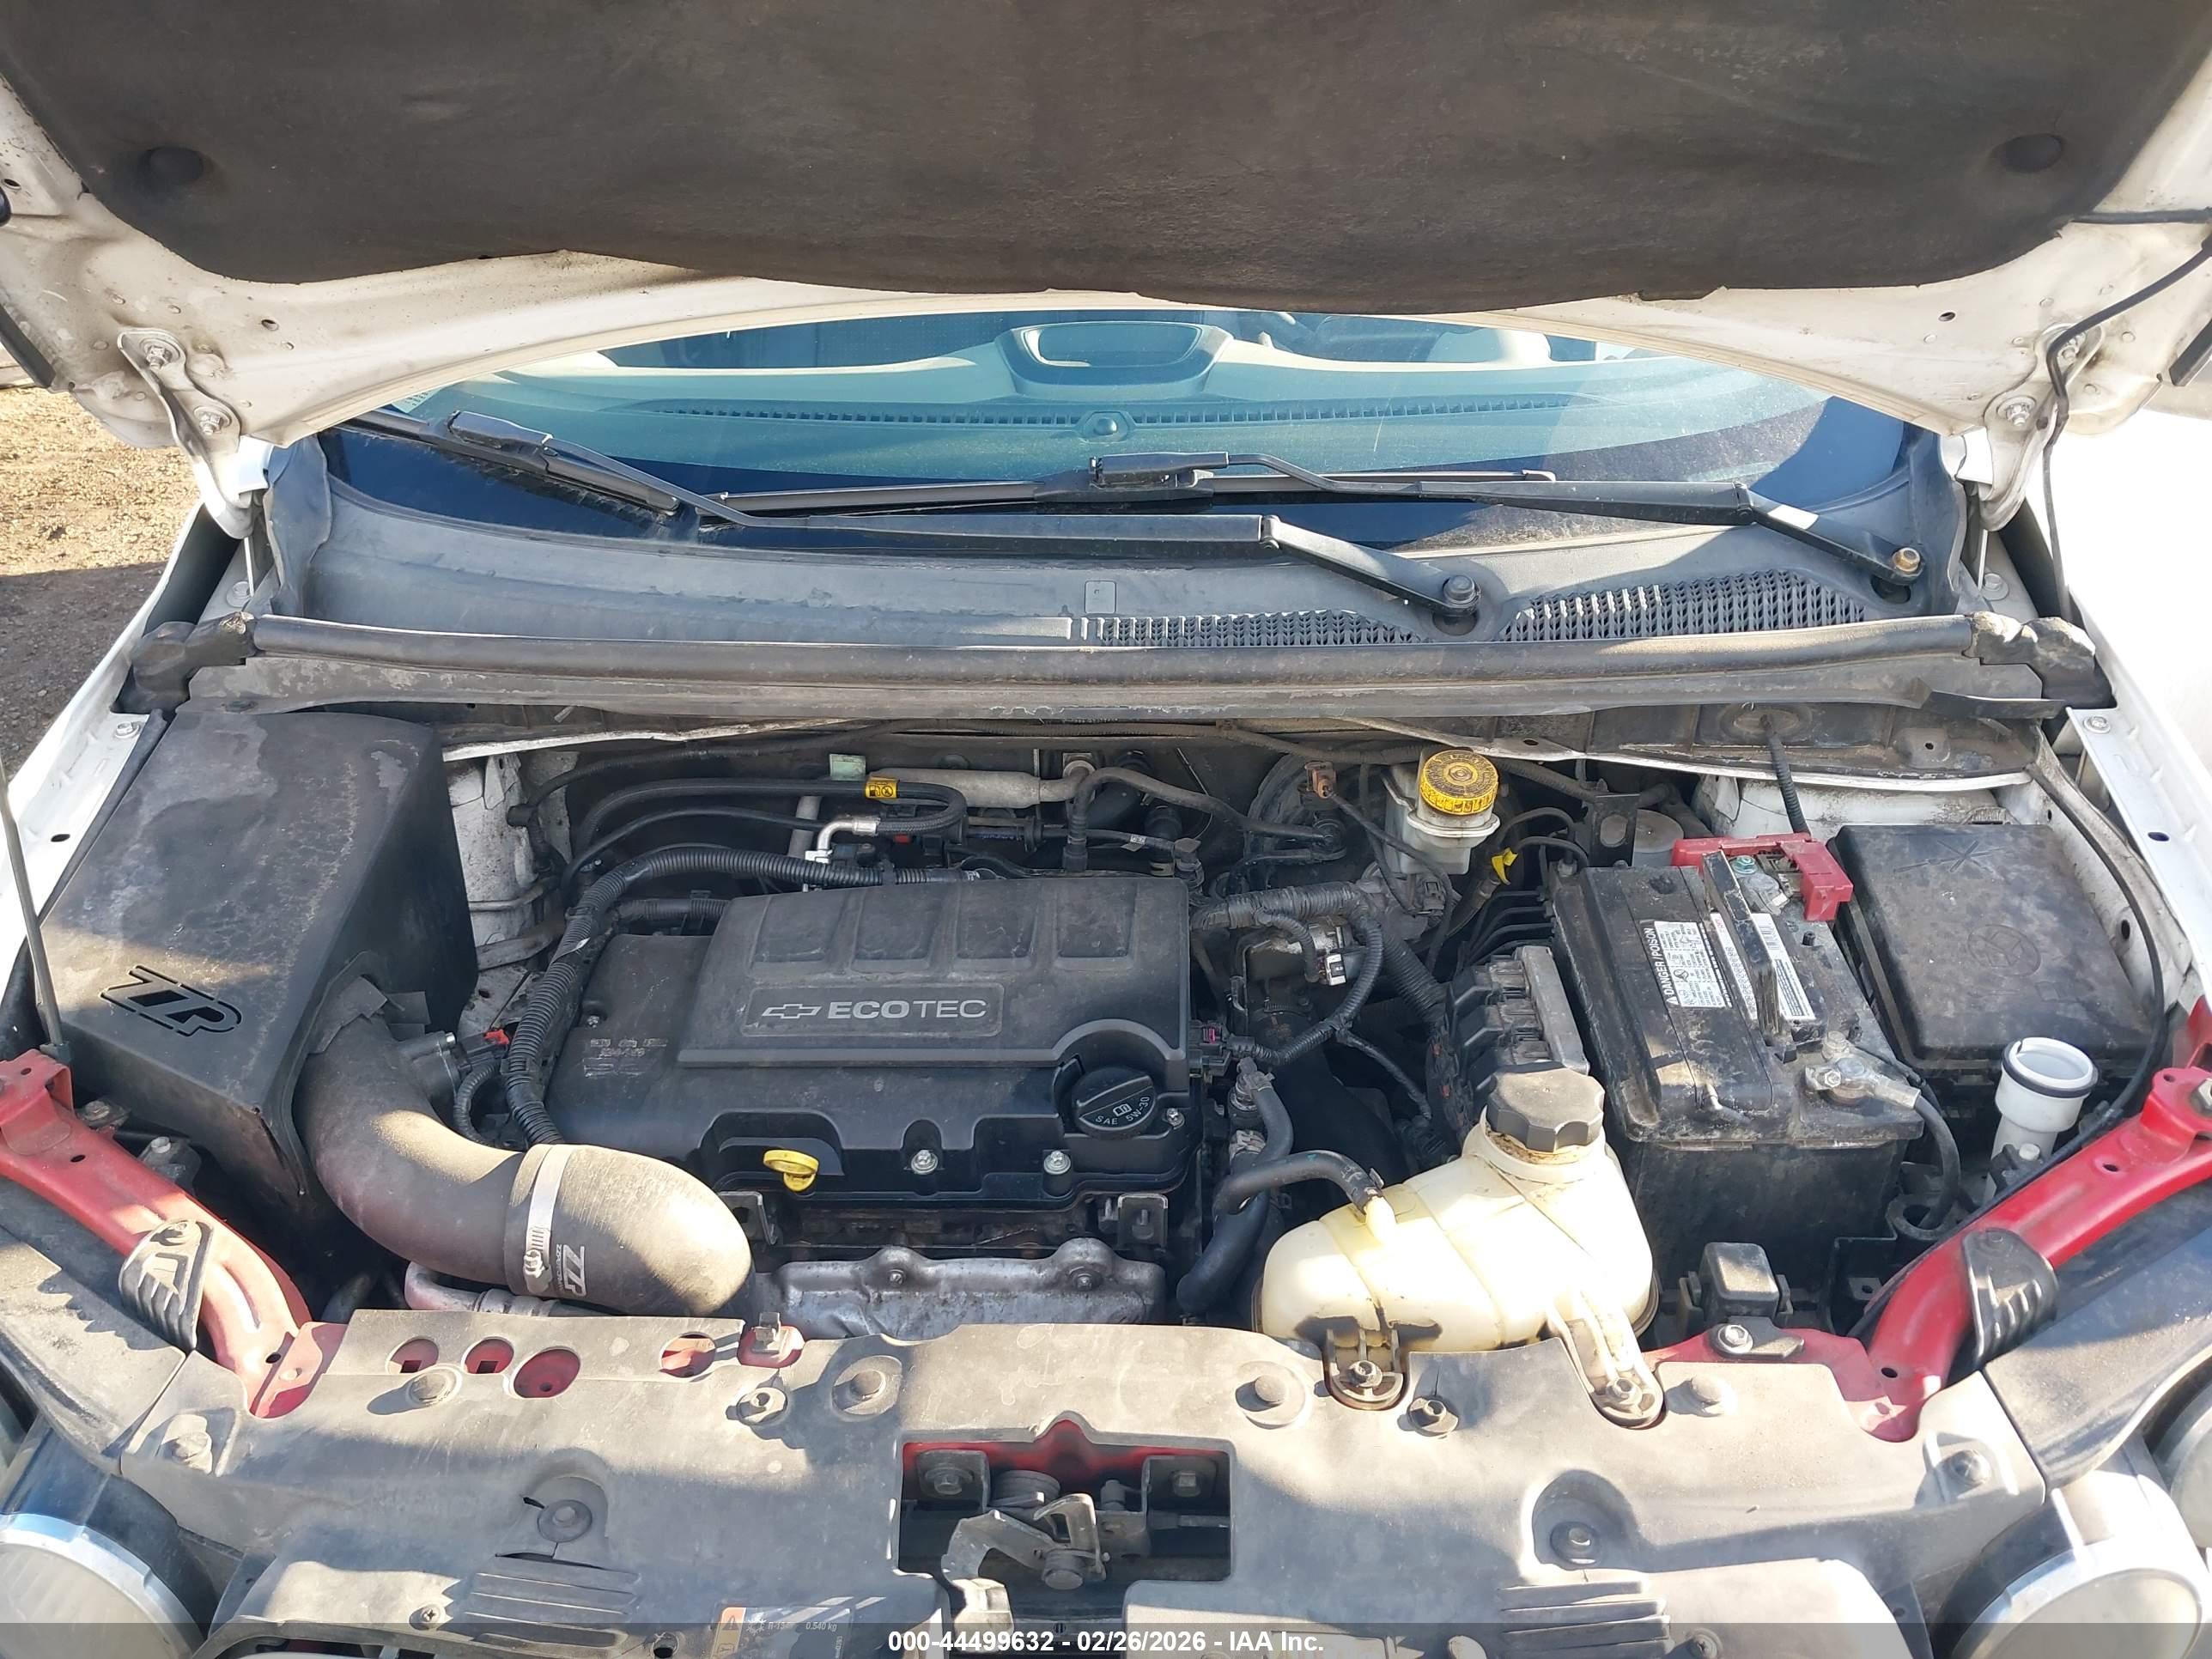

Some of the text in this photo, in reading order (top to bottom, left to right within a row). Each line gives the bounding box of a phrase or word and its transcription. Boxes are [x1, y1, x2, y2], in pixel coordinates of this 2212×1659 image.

[827, 1000, 988, 1019] ECOTEC
[1095, 1097, 1151, 1125] SAE 5W-30
[805, 1621, 827, 1631] 0.540
[827, 1621, 837, 1632] kg
